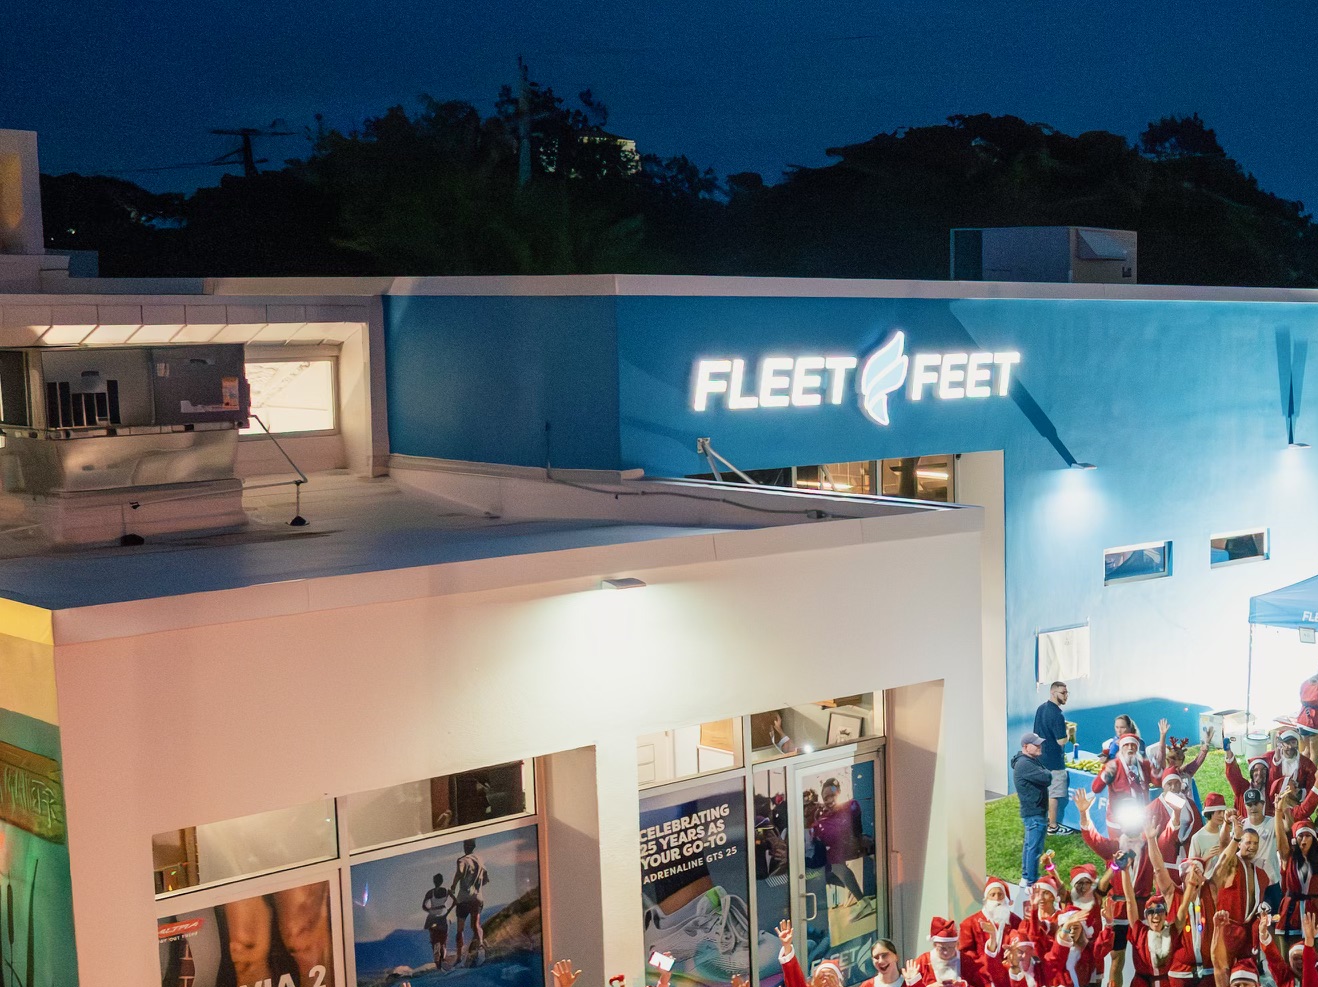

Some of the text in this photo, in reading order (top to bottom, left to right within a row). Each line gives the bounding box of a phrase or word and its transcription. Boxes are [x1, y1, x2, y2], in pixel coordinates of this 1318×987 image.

[694, 352, 1021, 412] FLEET FEET
[640, 803, 730, 843] CELEBRATING
[640, 818, 725, 856] 25 YEARS AS
[641, 832, 727, 870] YOUR GO-TO
[643, 845, 738, 885] ADRENALINE GTS 25
